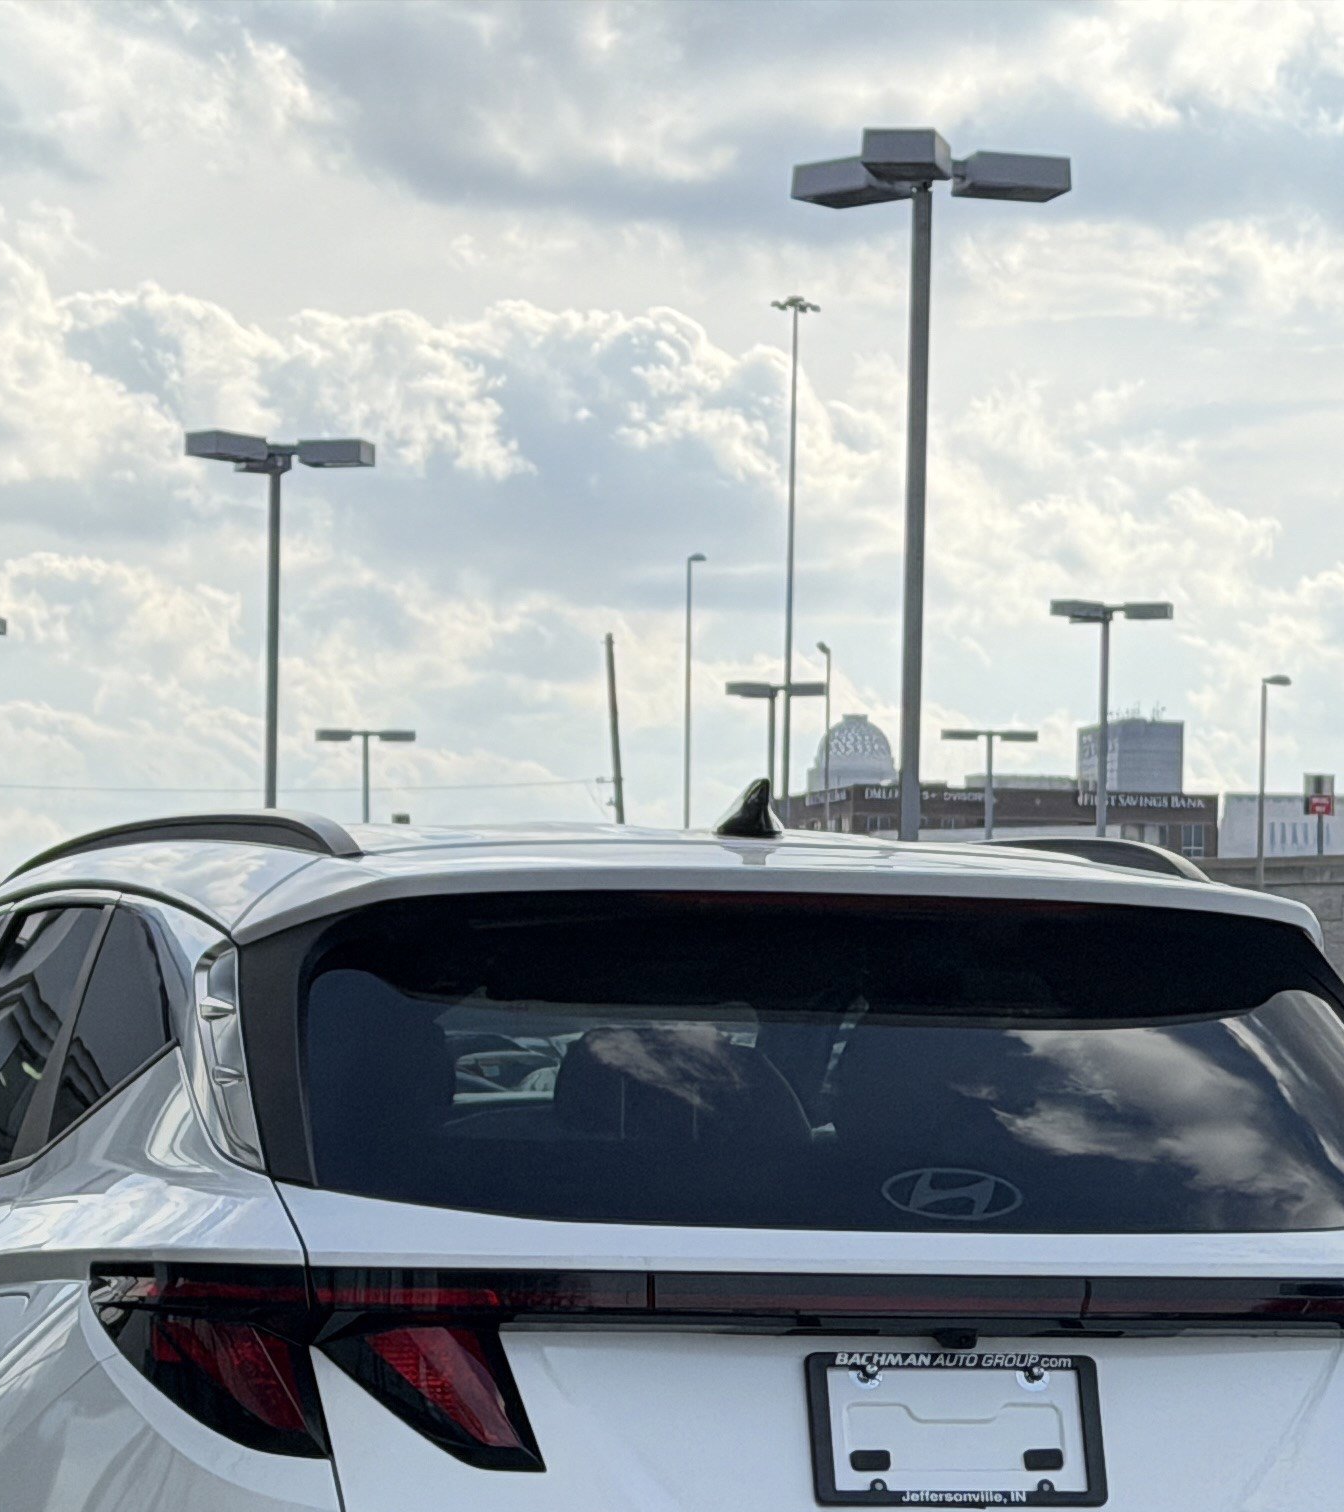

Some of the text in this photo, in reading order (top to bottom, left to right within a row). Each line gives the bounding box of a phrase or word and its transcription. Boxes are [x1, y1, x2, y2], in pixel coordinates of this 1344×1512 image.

[835, 1353, 930, 1366] BACHMAN
[933, 1354, 978, 1367] AUTO
[902, 1490, 1026, 1504] Jeffersonville, IN
